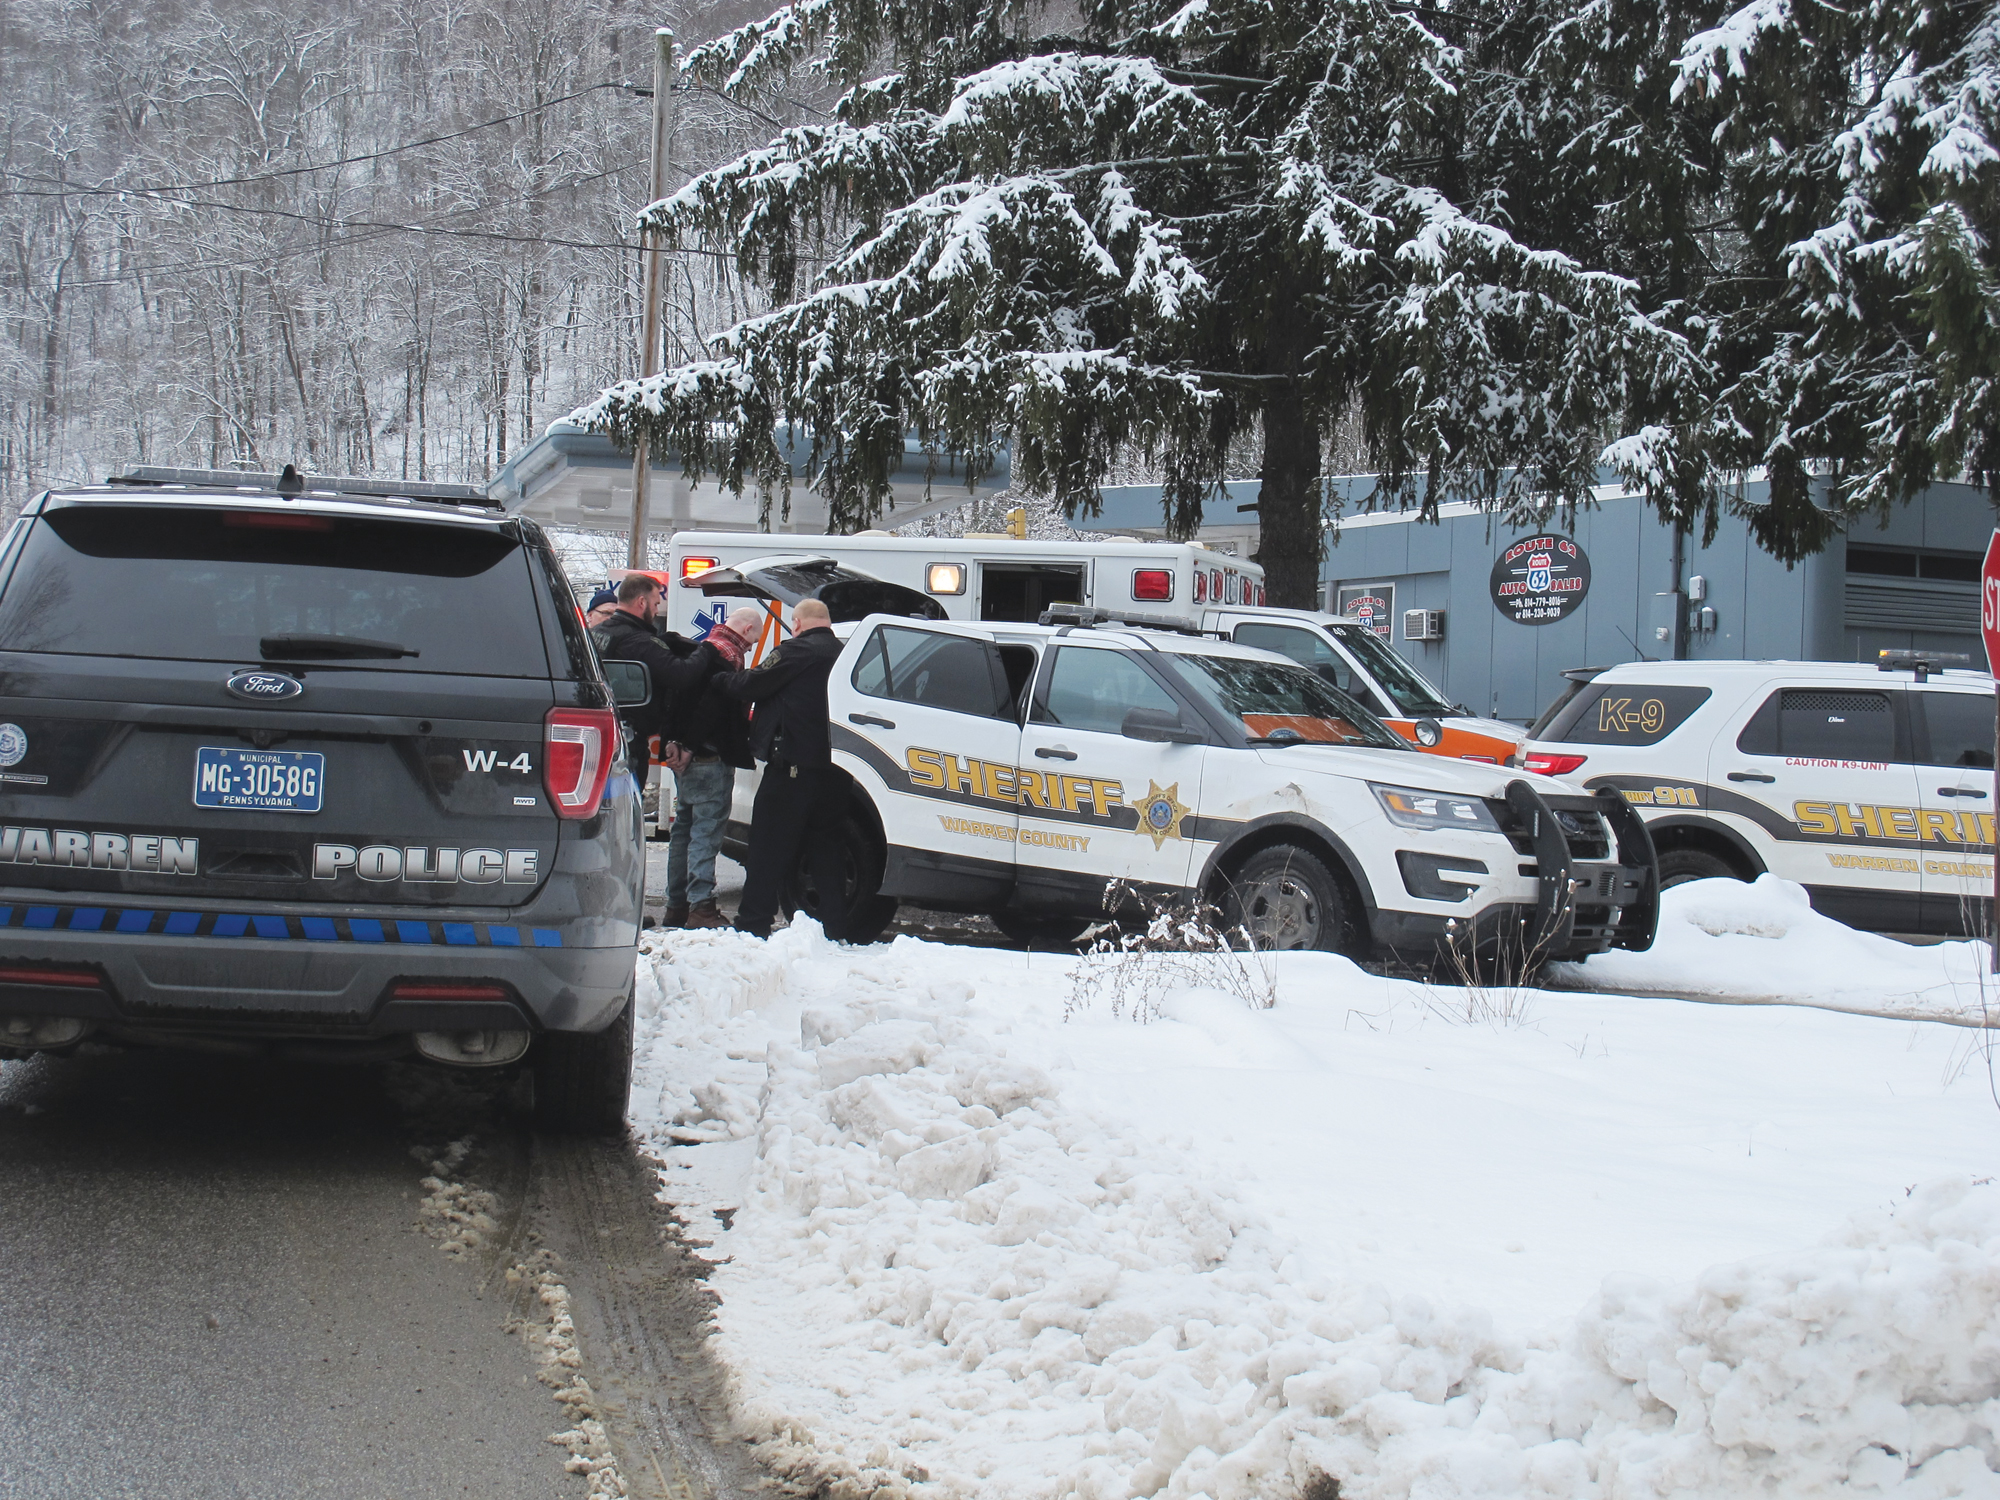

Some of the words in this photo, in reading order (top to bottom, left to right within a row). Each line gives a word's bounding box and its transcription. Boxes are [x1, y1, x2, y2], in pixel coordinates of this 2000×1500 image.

[1505, 537, 1554, 564] ROUTE
[1558, 540, 1577, 559] 62
[1531, 558, 1548, 567] ROUTE
[1498, 581, 1528, 596] AUTO
[1549, 576, 1582, 592] SALES
[1531, 570, 1547, 588] 62
[1346, 595, 1374, 612] ROUTE
[1374, 597, 1386, 610] 62
[244, 676, 285, 694] Ford
[1598, 697, 1665, 734] K-9
[239, 753, 282, 764] MUNICIPAL
[462, 749, 533, 774] W-4
[1785, 757, 1839, 769] CAUTION
[1841, 760, 1890, 771] K9-UNIT
[201, 762, 316, 797] MG-3058G
[905, 745, 1125, 819] SHERIFF
[223, 795, 292, 807] PENNSYLVANIA
[1653, 785, 1700, 806] 911
[937, 814, 1018, 843] WARREN
[1019, 829, 1091, 852] COUNTY
[312, 842, 539, 885] POLICE
[1825, 852, 1921, 874] WARREN
